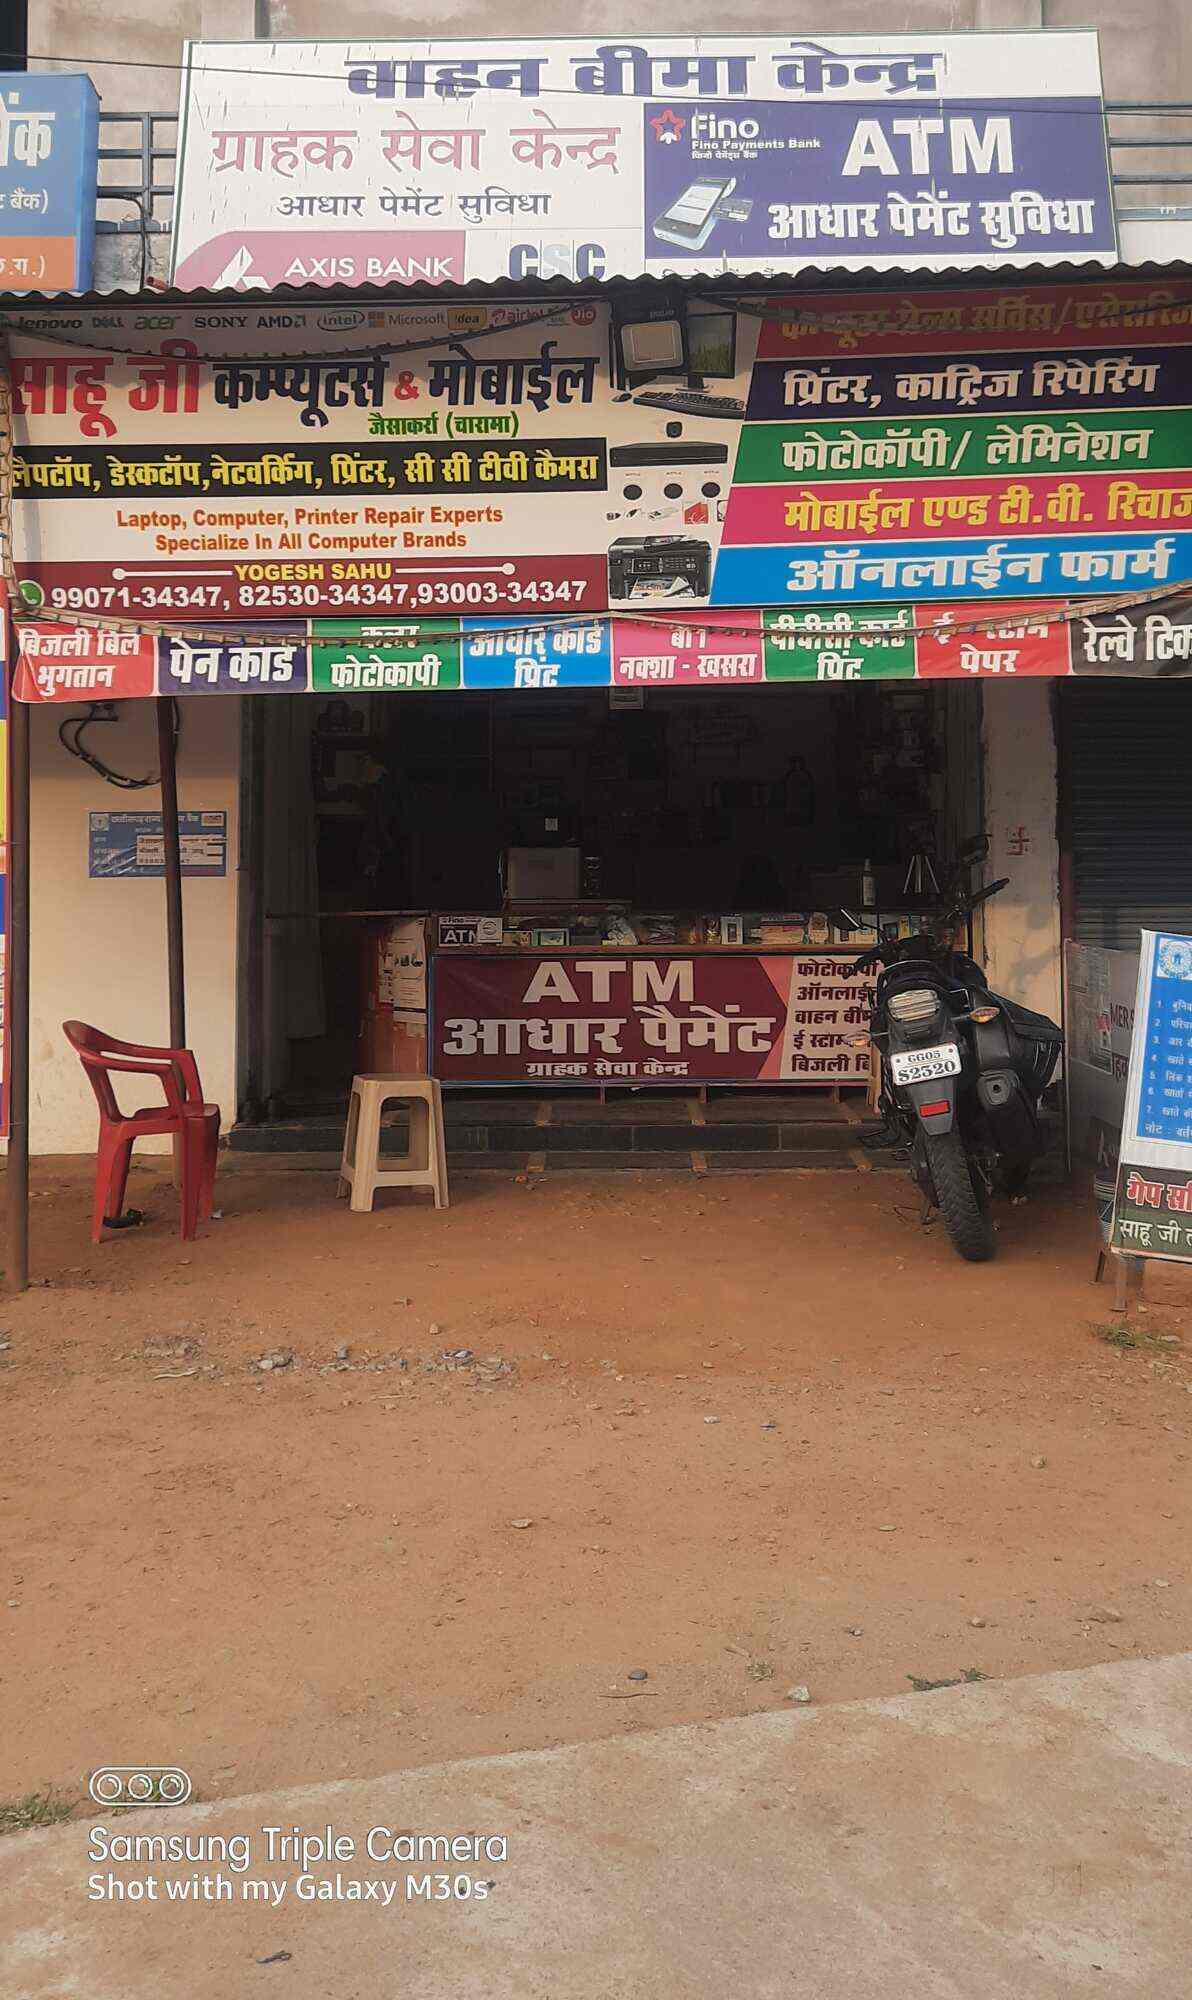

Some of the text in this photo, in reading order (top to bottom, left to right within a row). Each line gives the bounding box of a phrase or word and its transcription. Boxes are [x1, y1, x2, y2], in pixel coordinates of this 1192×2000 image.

[344, 42, 944, 98] वाहन बीमा केन्द्र
[691, 112, 760, 138] Fino
[212, 109, 621, 177] ग्राहक सेवा केन्द्र
[692, 138, 821, 151] Fino Payments Bank
[842, 118, 1013, 176] ATM
[276, 186, 552, 223] आधार पेमेंट सुविधा
[768, 190, 1094, 248] आधार पेमेंट सुविधा
[284, 256, 454, 277] AXIS BANK
[509, 243, 607, 280] CSC
[135, 315, 176, 330] acer
[194, 316, 248, 328] SONY
[257, 315, 293, 328] AMD
[388, 314, 446, 326] Microsoft
[11, 357, 118, 438] साहू
[126, 338, 207, 413] जी
[394, 370, 419, 400] &
[428, 341, 600, 413] मोबाईल
[782, 367, 882, 409] प्रिंटर,
[985, 421, 1154, 466] लेमिनेशन
[331, 452, 396, 489] प्रिंटर,
[404, 451, 435, 483] सी
[441, 451, 472, 482] सी
[479, 450, 529, 482] टीवी
[534, 448, 599, 481] कैमरा
[116, 505, 503, 530] Laptop, Computer, Printer Repair Experts
[783, 488, 913, 534] मोबाईल
[922, 494, 992, 527] एण्ड
[155, 530, 467, 554] Specialize In All Computer Brands
[234, 562, 392, 582] YOGESH SAHU
[786, 537, 1176, 591] ऑनलाईन फार्म
[51, 586, 230, 611] 99071-34347,
[19, 628, 141, 656] बिजली बिल
[960, 643, 1021, 673] पेपर
[170, 637, 223, 684] पेन
[620, 656, 677, 681] नक्शा
[697, 653, 757, 678] खसरा
[38, 664, 116, 696] भुगतान
[523, 960, 694, 1003] ATM
[795, 1010, 838, 1024] वाहन
[443, 1017, 627, 1055] आधार
[526, 1057, 690, 1077] ग्राहक सेवा केन्द्र
[791, 1054, 851, 1072] बिजली
[1119, 1220, 1153, 1247] साहू
[1158, 1220, 1182, 1244] जी
